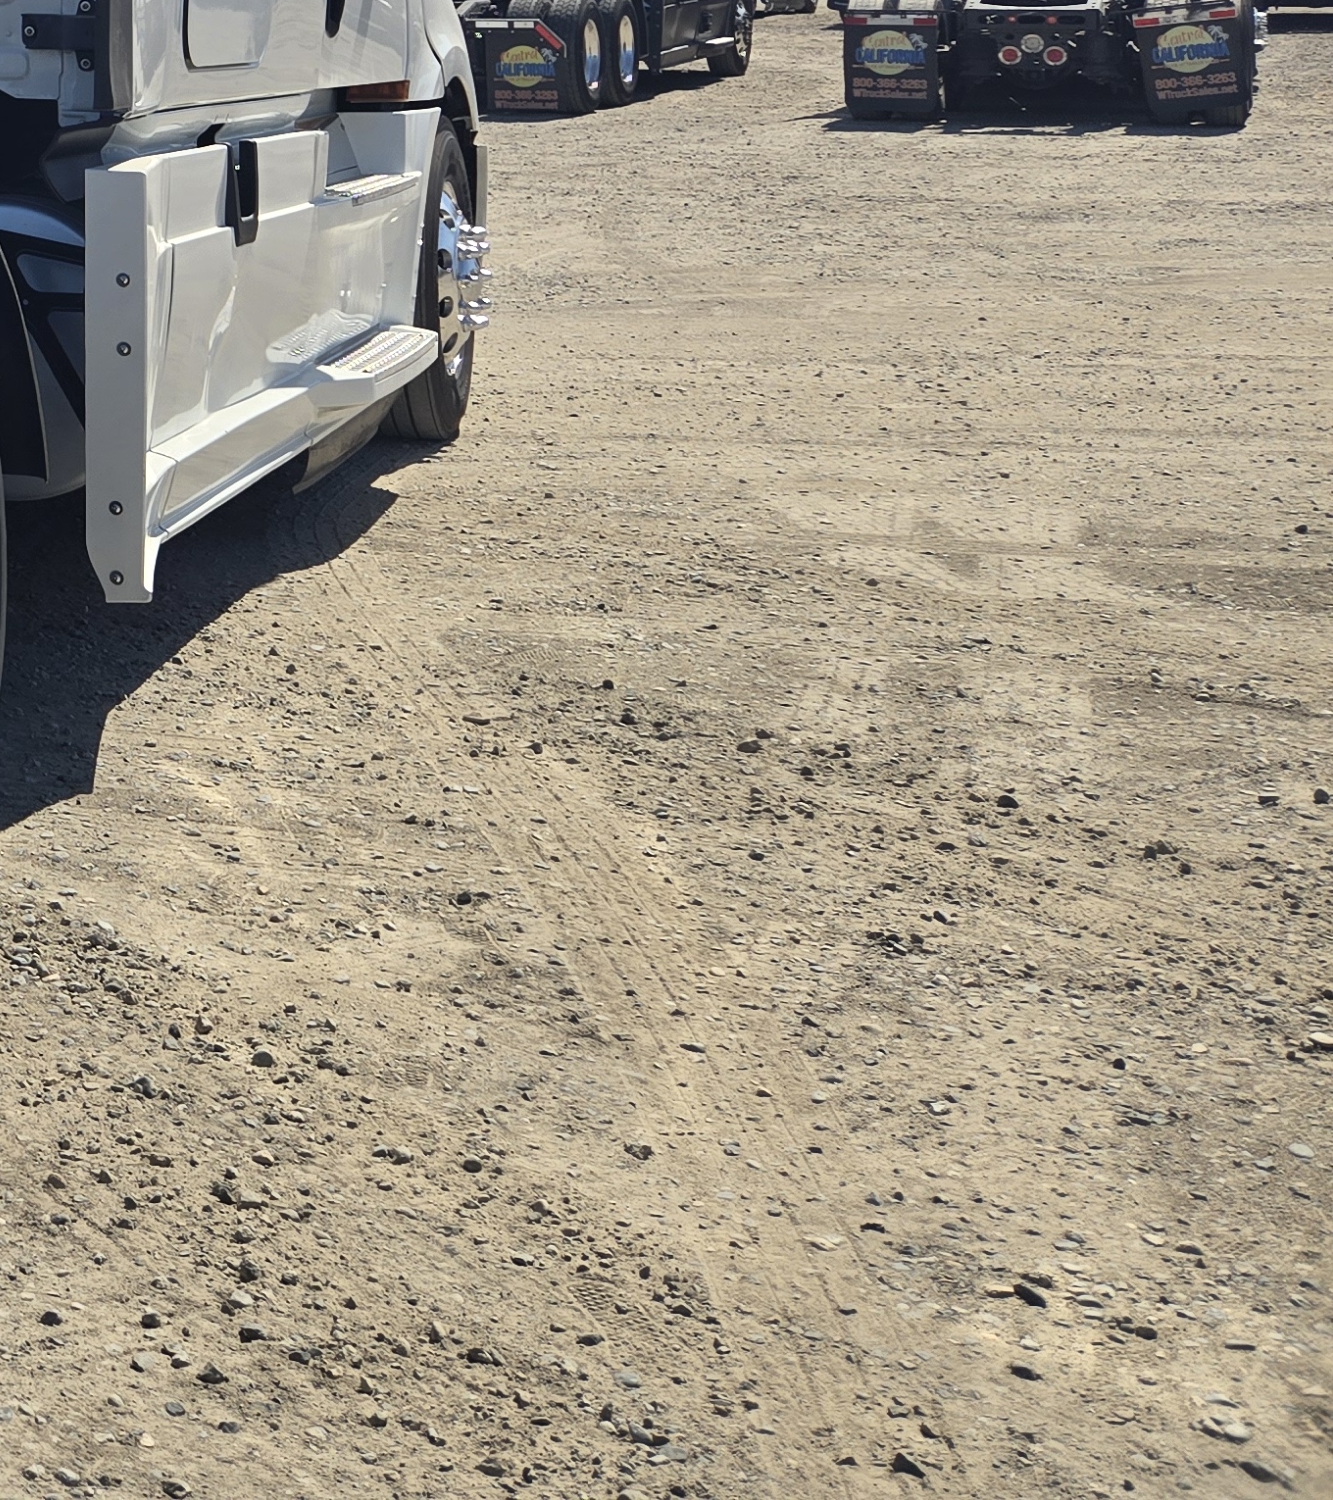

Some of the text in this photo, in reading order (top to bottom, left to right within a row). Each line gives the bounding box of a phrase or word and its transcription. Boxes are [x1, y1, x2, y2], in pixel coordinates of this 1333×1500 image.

[855, 47, 926, 64] CALIFORNIA
[1152, 42, 1230, 63] CALIFORNIA
[496, 62, 556, 77] CALIFORNIA
